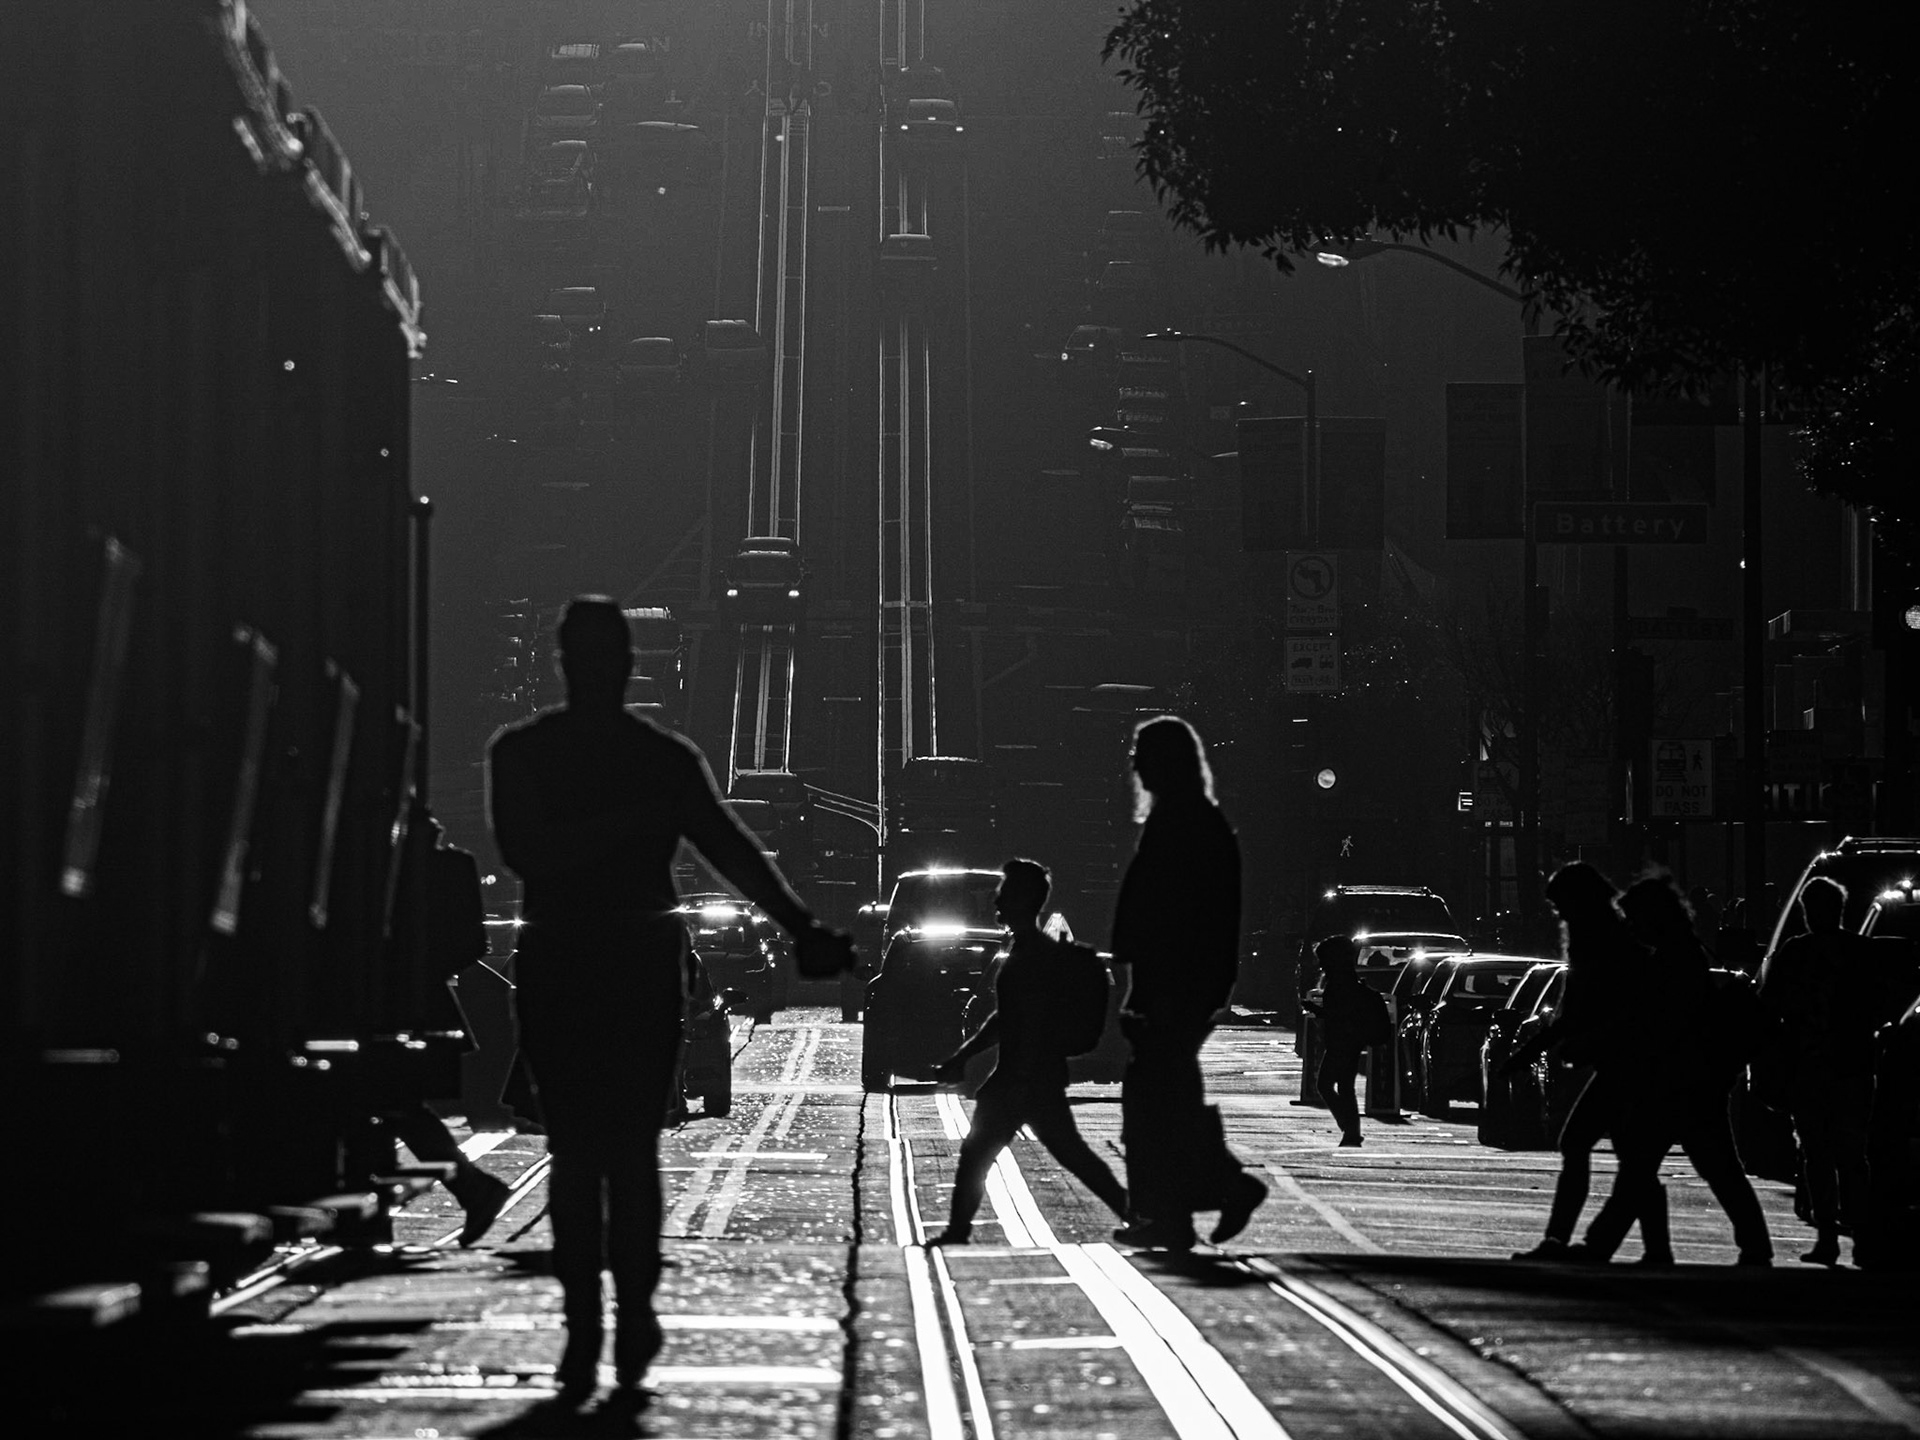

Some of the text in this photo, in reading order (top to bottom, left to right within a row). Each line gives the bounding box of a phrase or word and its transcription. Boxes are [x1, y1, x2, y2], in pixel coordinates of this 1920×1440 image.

[1556, 512, 1685, 540] Battery
[1655, 785, 1708, 798] DO NOT
[1664, 801, 1700, 814] PASS
